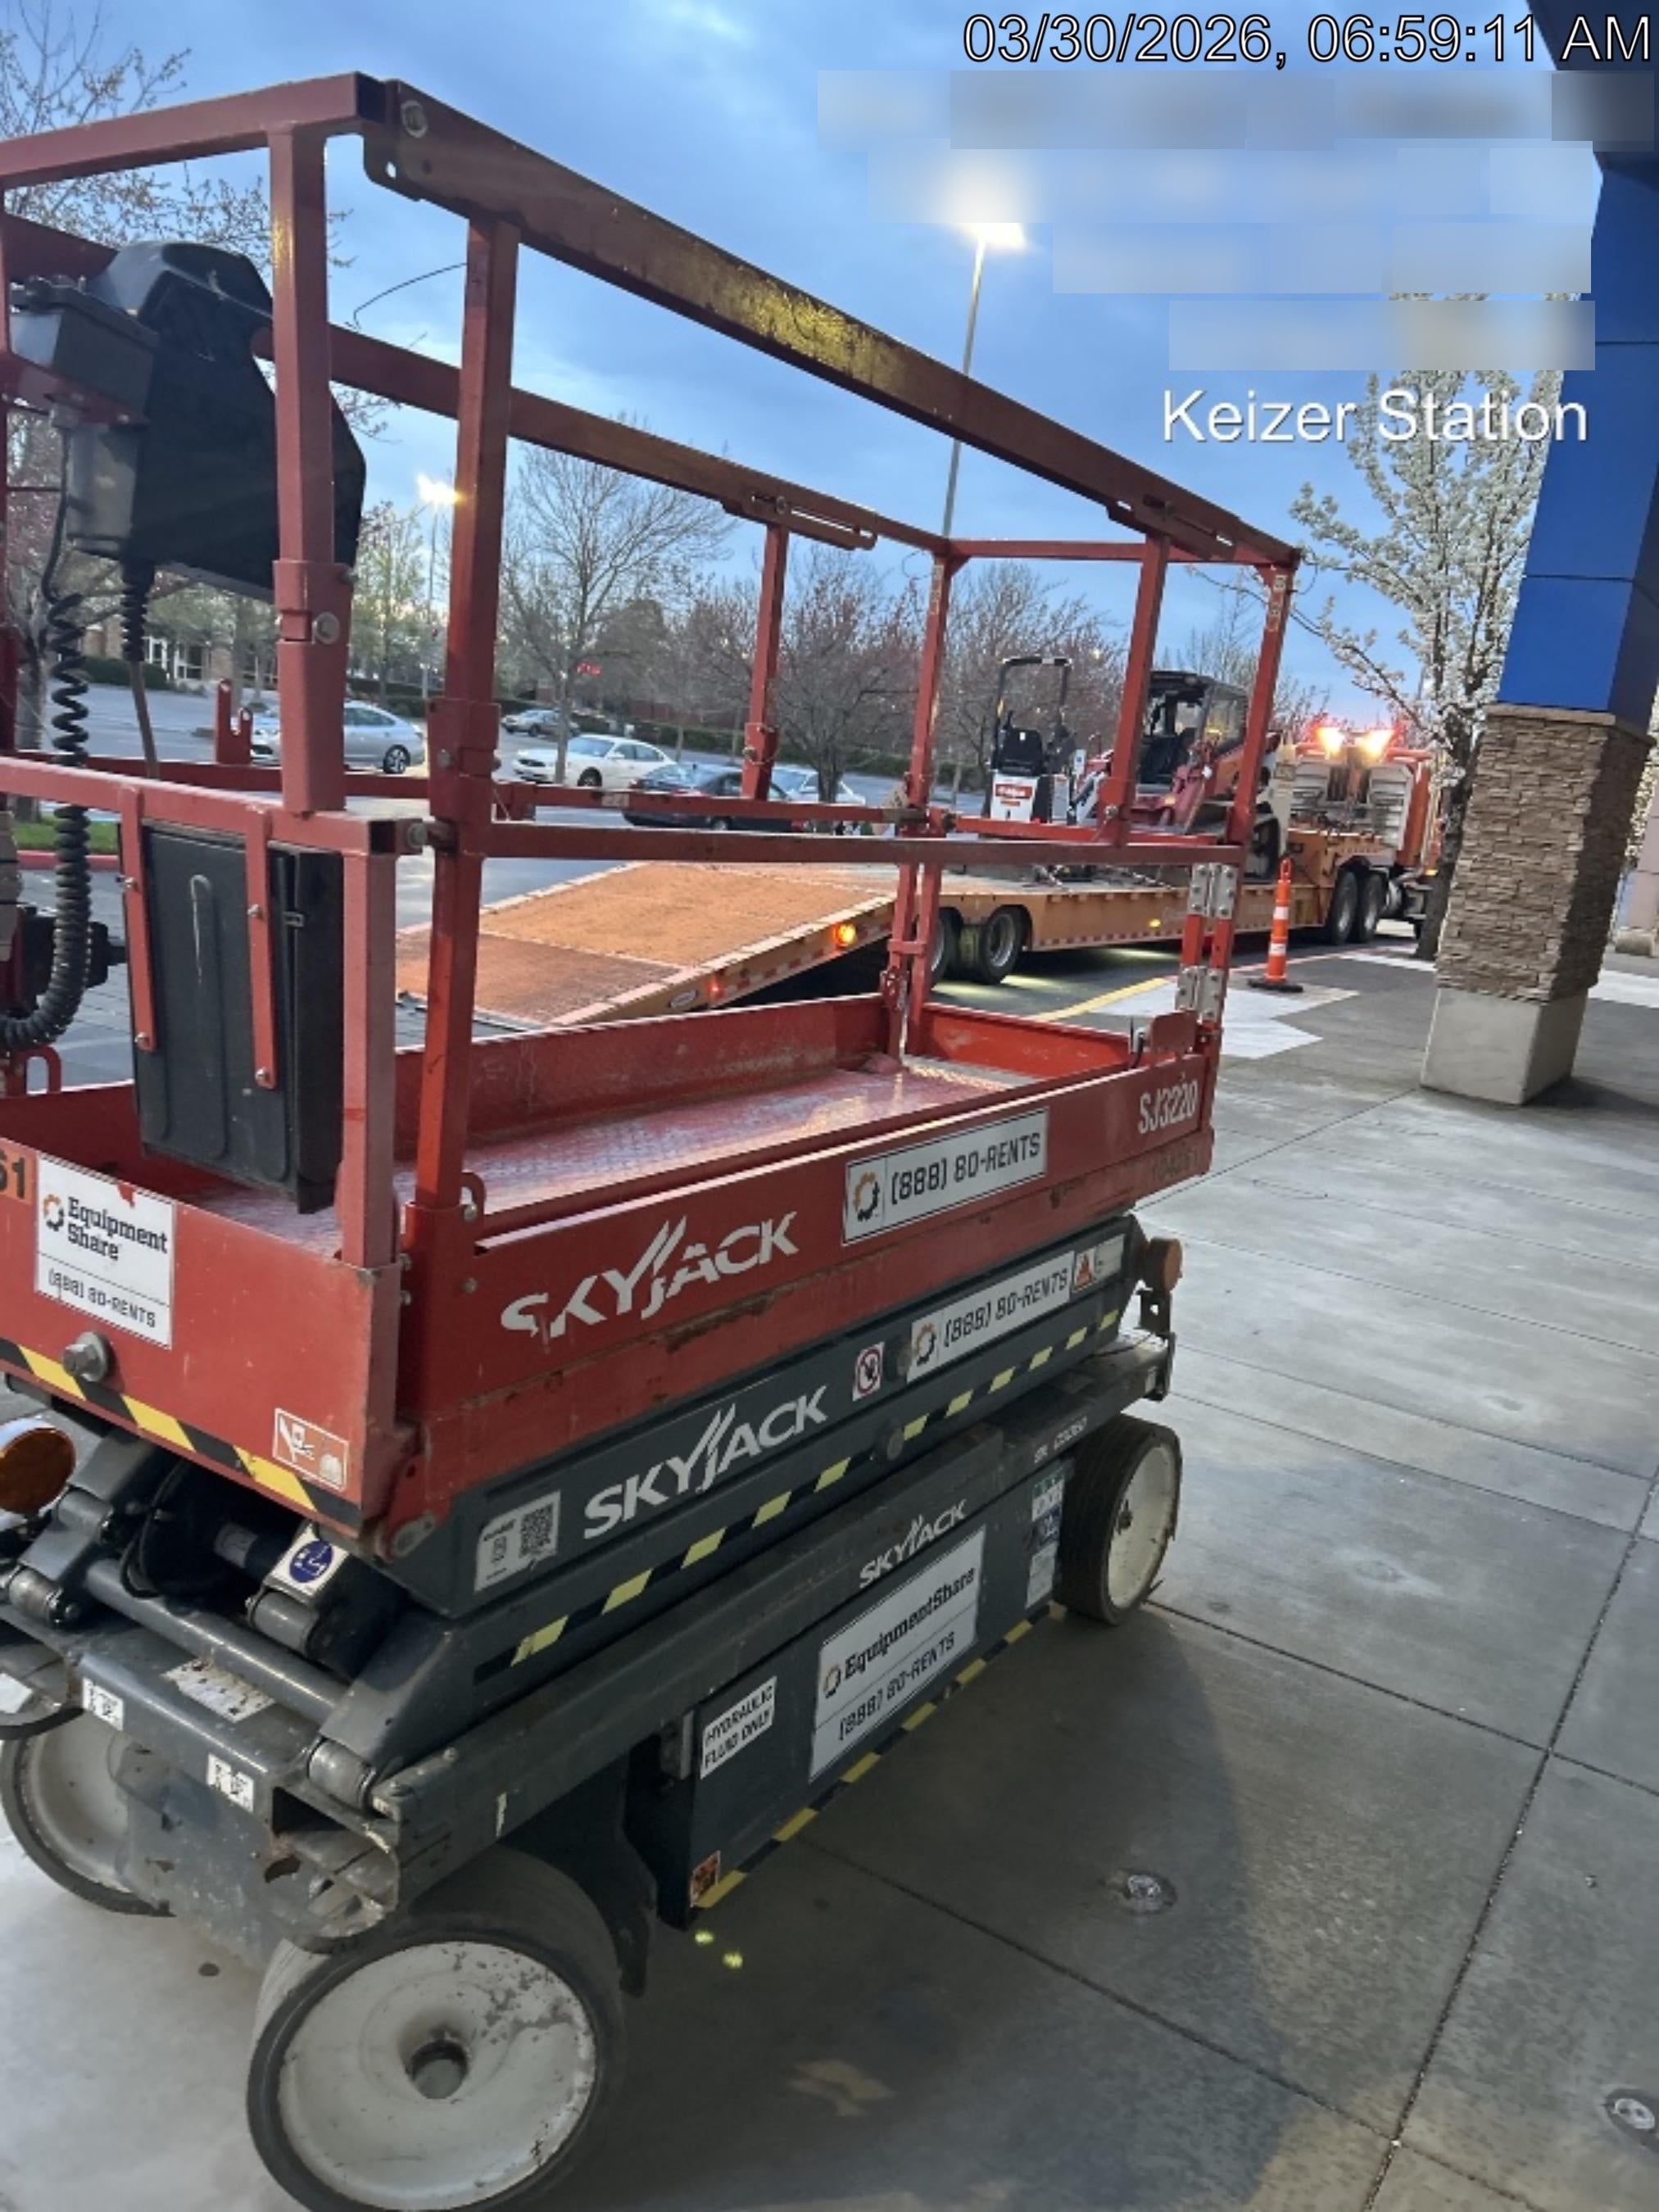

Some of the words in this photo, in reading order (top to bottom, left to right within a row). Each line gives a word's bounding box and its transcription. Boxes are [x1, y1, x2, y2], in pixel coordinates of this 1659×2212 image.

[1138, 1080, 1198, 1134] SJ3220
[891, 1158, 946, 1205] (888)
[954, 1132, 1040, 1182] 80-RENTS
[68, 1197, 167, 1253] Equipment
[68, 1223, 119, 1261] Share
[501, 1212, 799, 1338] SKYJACK
[944, 1304, 991, 1348] (888)
[995, 1267, 1067, 1321] 80-RENTS
[584, 1384, 829, 1539] SKYJACK
[859, 1499, 967, 1588] SKYJACK
[845, 1566, 975, 1679] EquipmentShare
[705, 1685, 773, 1747] HYDRAULIC
[705, 1733, 737, 1770] FLUID
[741, 1710, 769, 1740] ONLY
[839, 1690, 882, 1741] (888)
